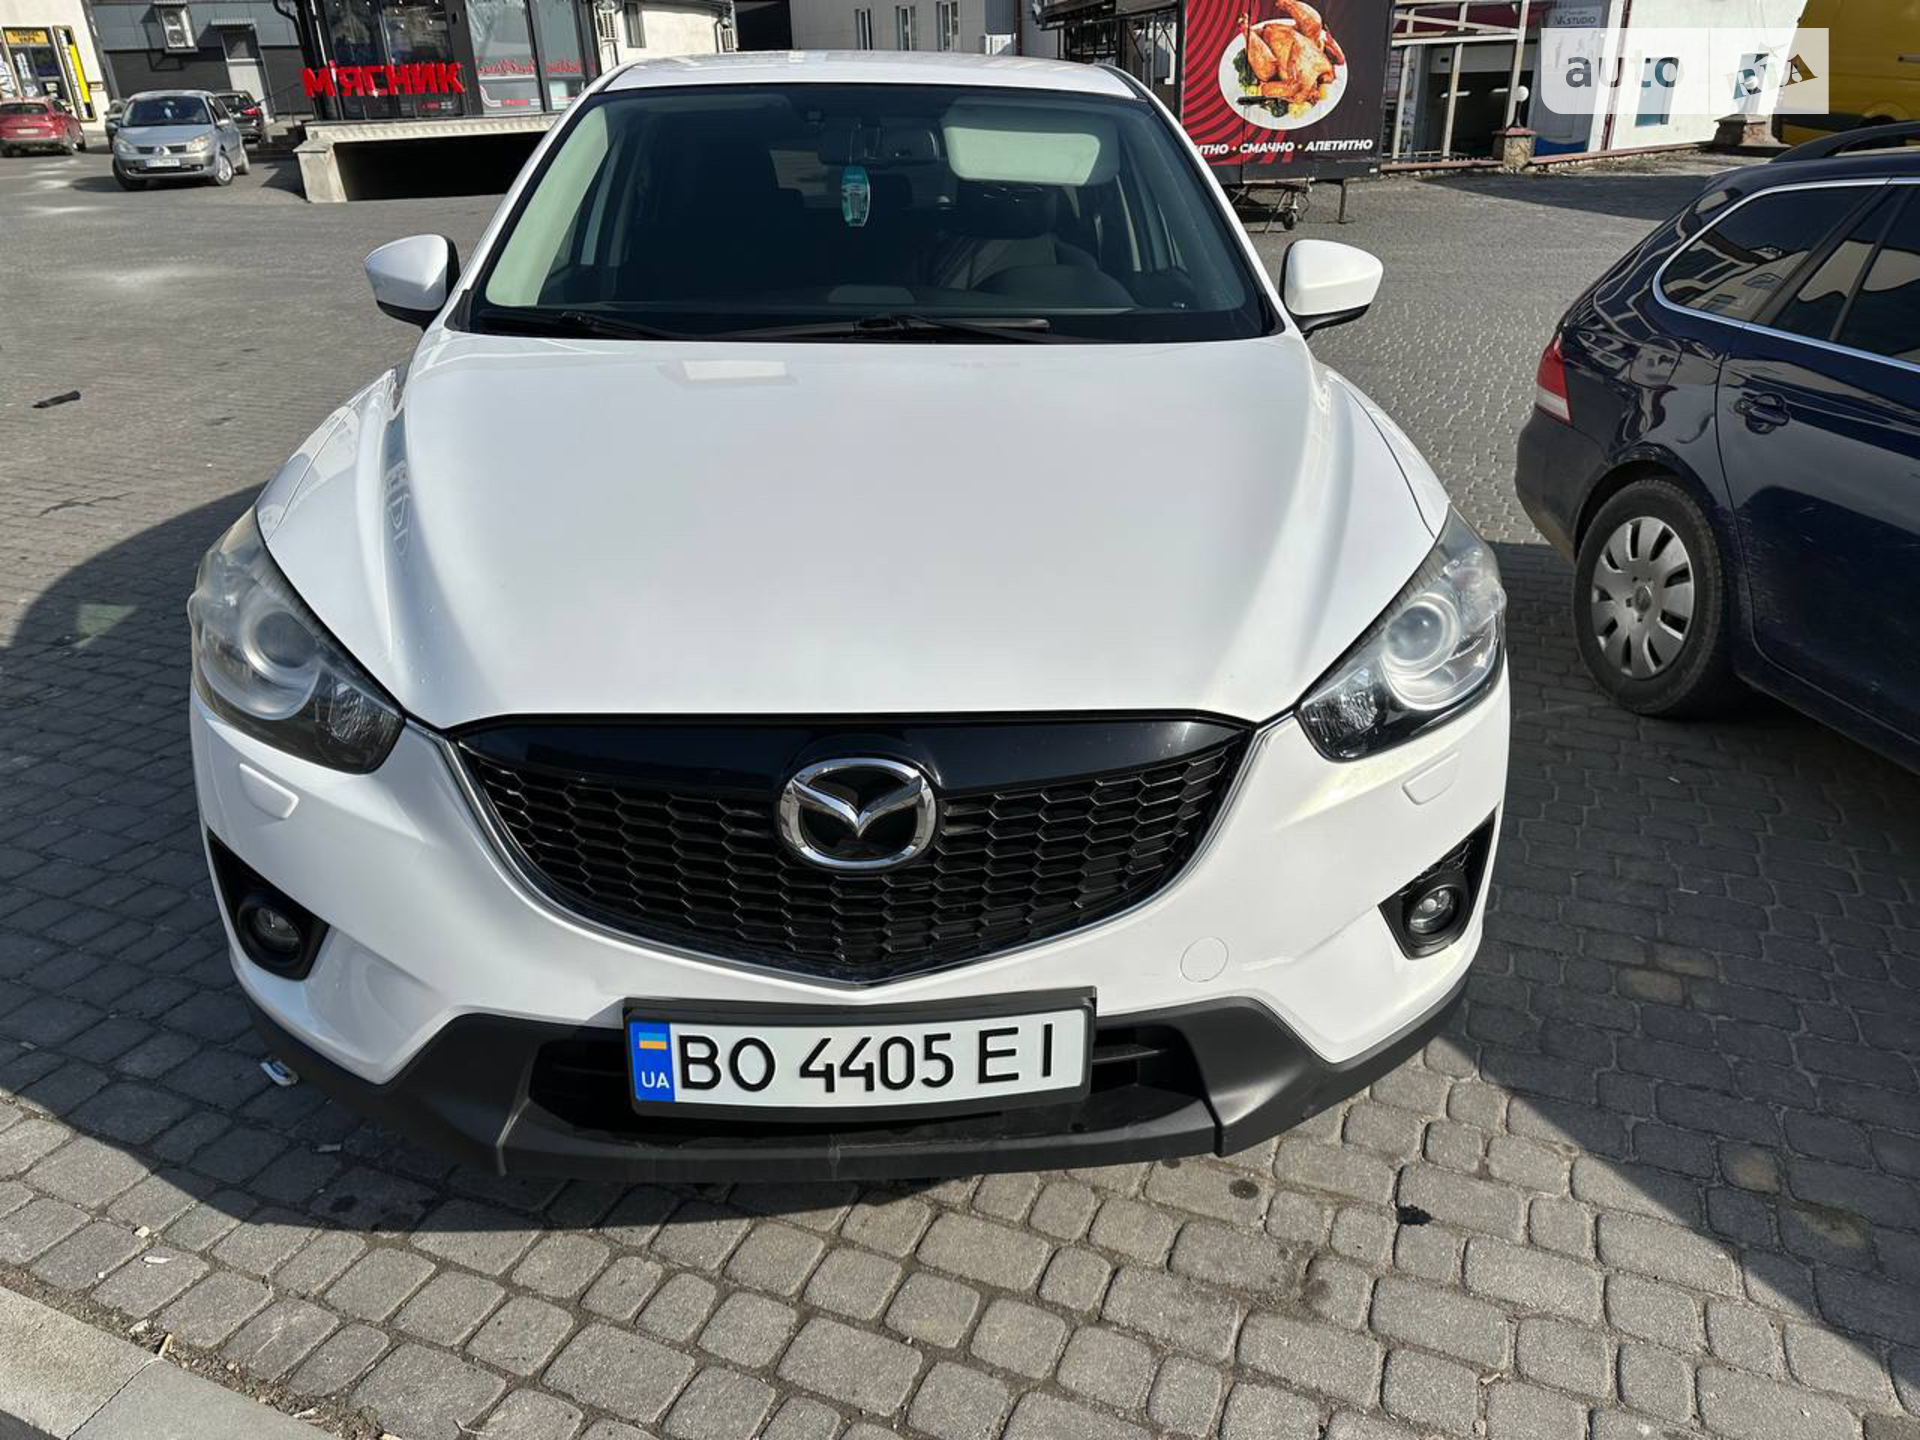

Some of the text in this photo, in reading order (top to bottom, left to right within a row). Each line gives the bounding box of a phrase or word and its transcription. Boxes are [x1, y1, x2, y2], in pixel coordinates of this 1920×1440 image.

[1239, 141, 1295, 154] СМАЧНО
[1304, 138, 1374, 152] АПЕТИТНО
[678, 1034, 776, 1093] BO
[799, 1032, 955, 1093] 4405
[641, 1070, 670, 1089] UA
